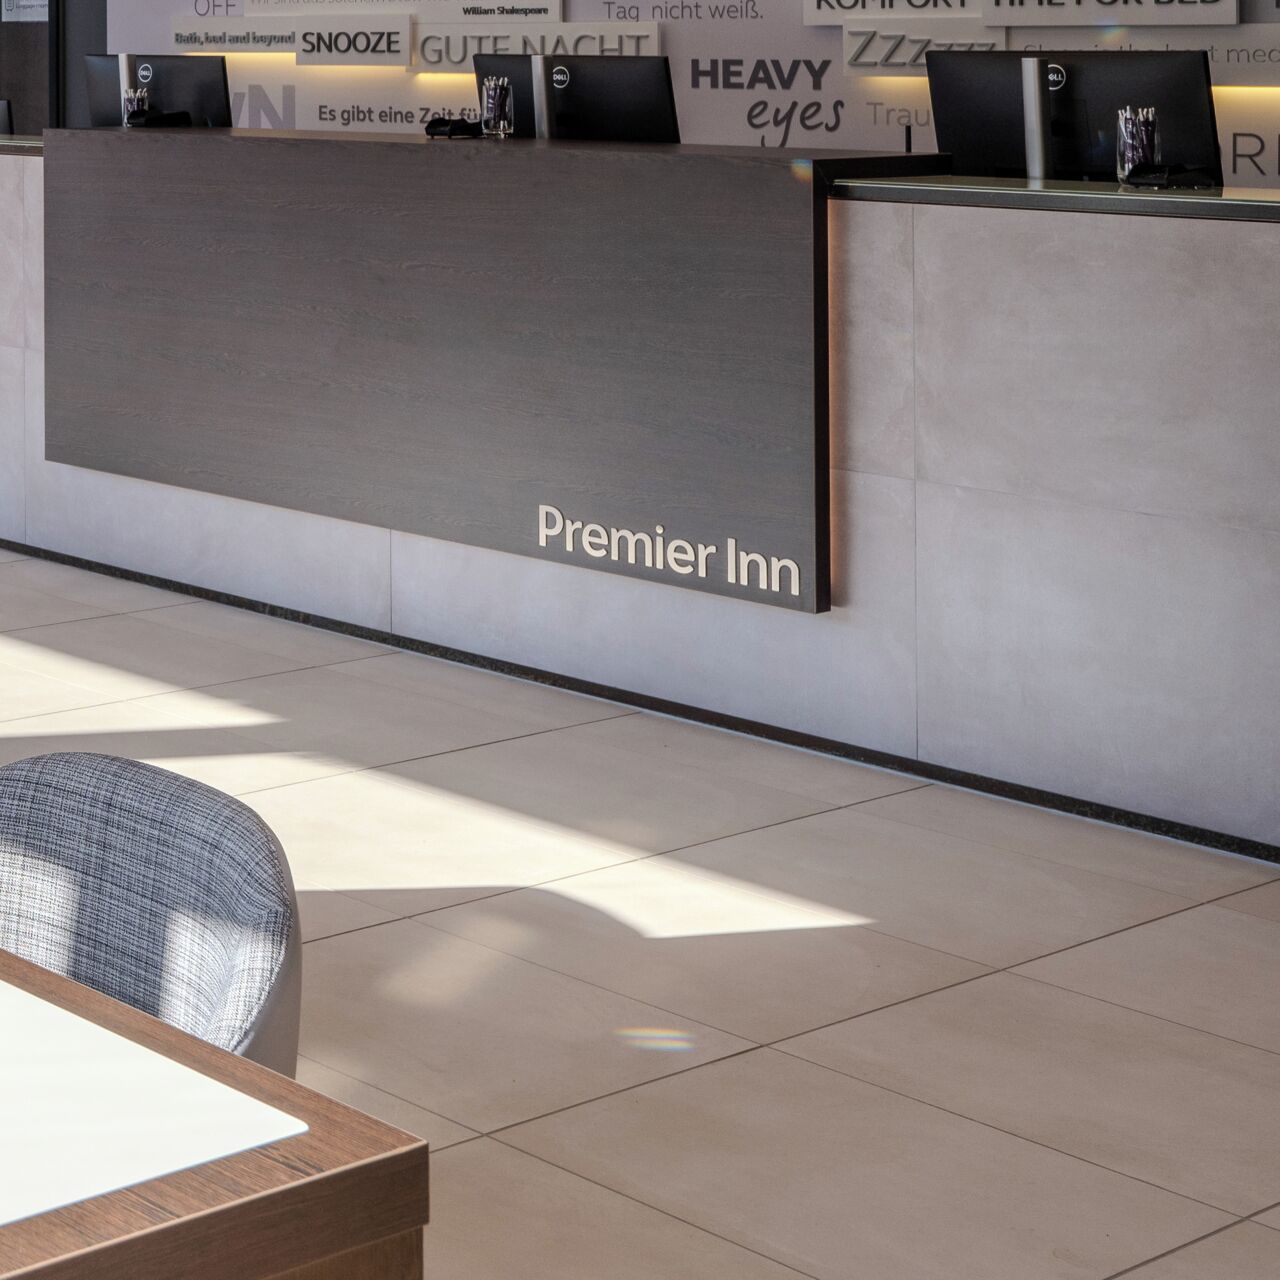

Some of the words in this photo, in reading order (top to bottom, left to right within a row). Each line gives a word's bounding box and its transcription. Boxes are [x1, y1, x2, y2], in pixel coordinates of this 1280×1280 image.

[463, 6, 495, 16] William
[497, 6, 548, 17] Shakespeare
[603, 1, 640, 22] Tag
[652, 0, 701, 19] nicht
[708, 0, 763, 19] weiß.
[301, 31, 401, 54] SNOOZE
[420, 35, 510, 65] GUTE
[522, 34, 650, 56] NACHT
[690, 58, 832, 91] HEAVY
[318, 105, 336, 121] Es
[341, 105, 374, 126] gibt
[378, 106, 415, 124] eine
[746, 99, 845, 148] eyes
[538, 504, 717, 578] Premier
[727, 537, 800, 596] Inn
